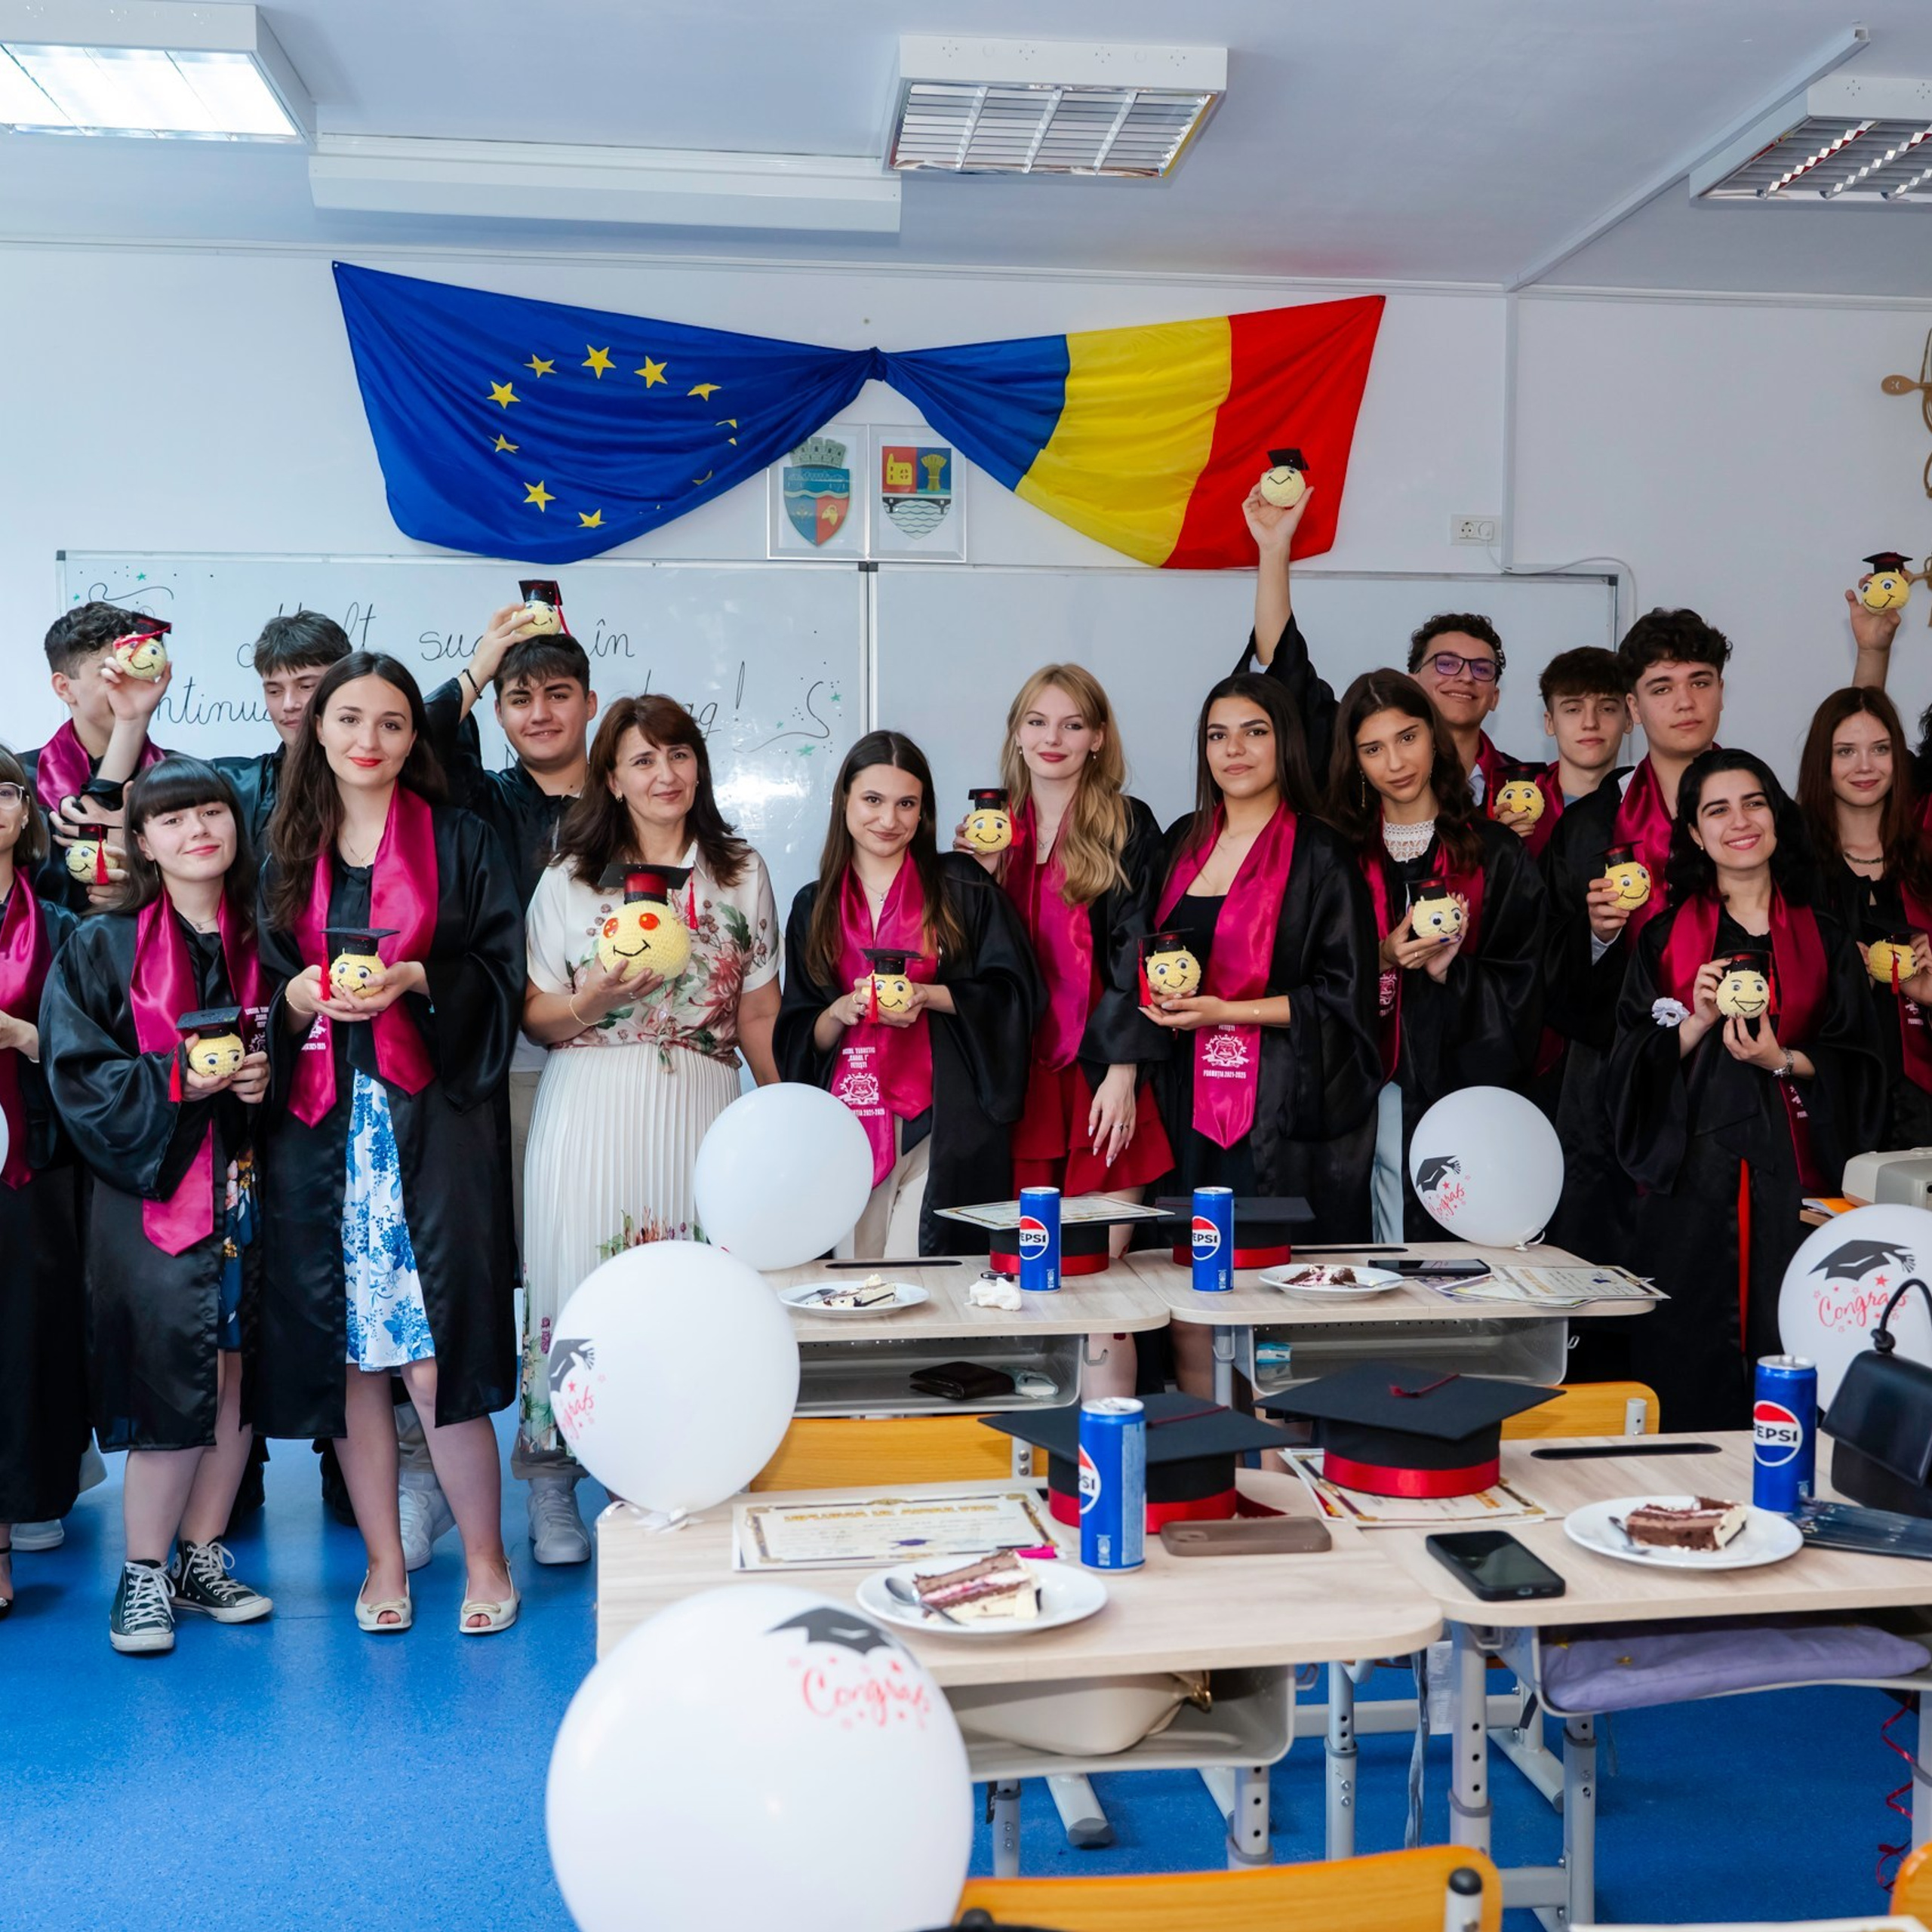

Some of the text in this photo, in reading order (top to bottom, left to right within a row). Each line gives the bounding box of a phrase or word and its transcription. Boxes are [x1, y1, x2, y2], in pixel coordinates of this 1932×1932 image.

[589, 619, 635, 657] în
[1020, 1232, 1047, 1243] EPSI
[1193, 1232, 1217, 1244] EPSI
[1819, 1292, 1909, 1327] Congras
